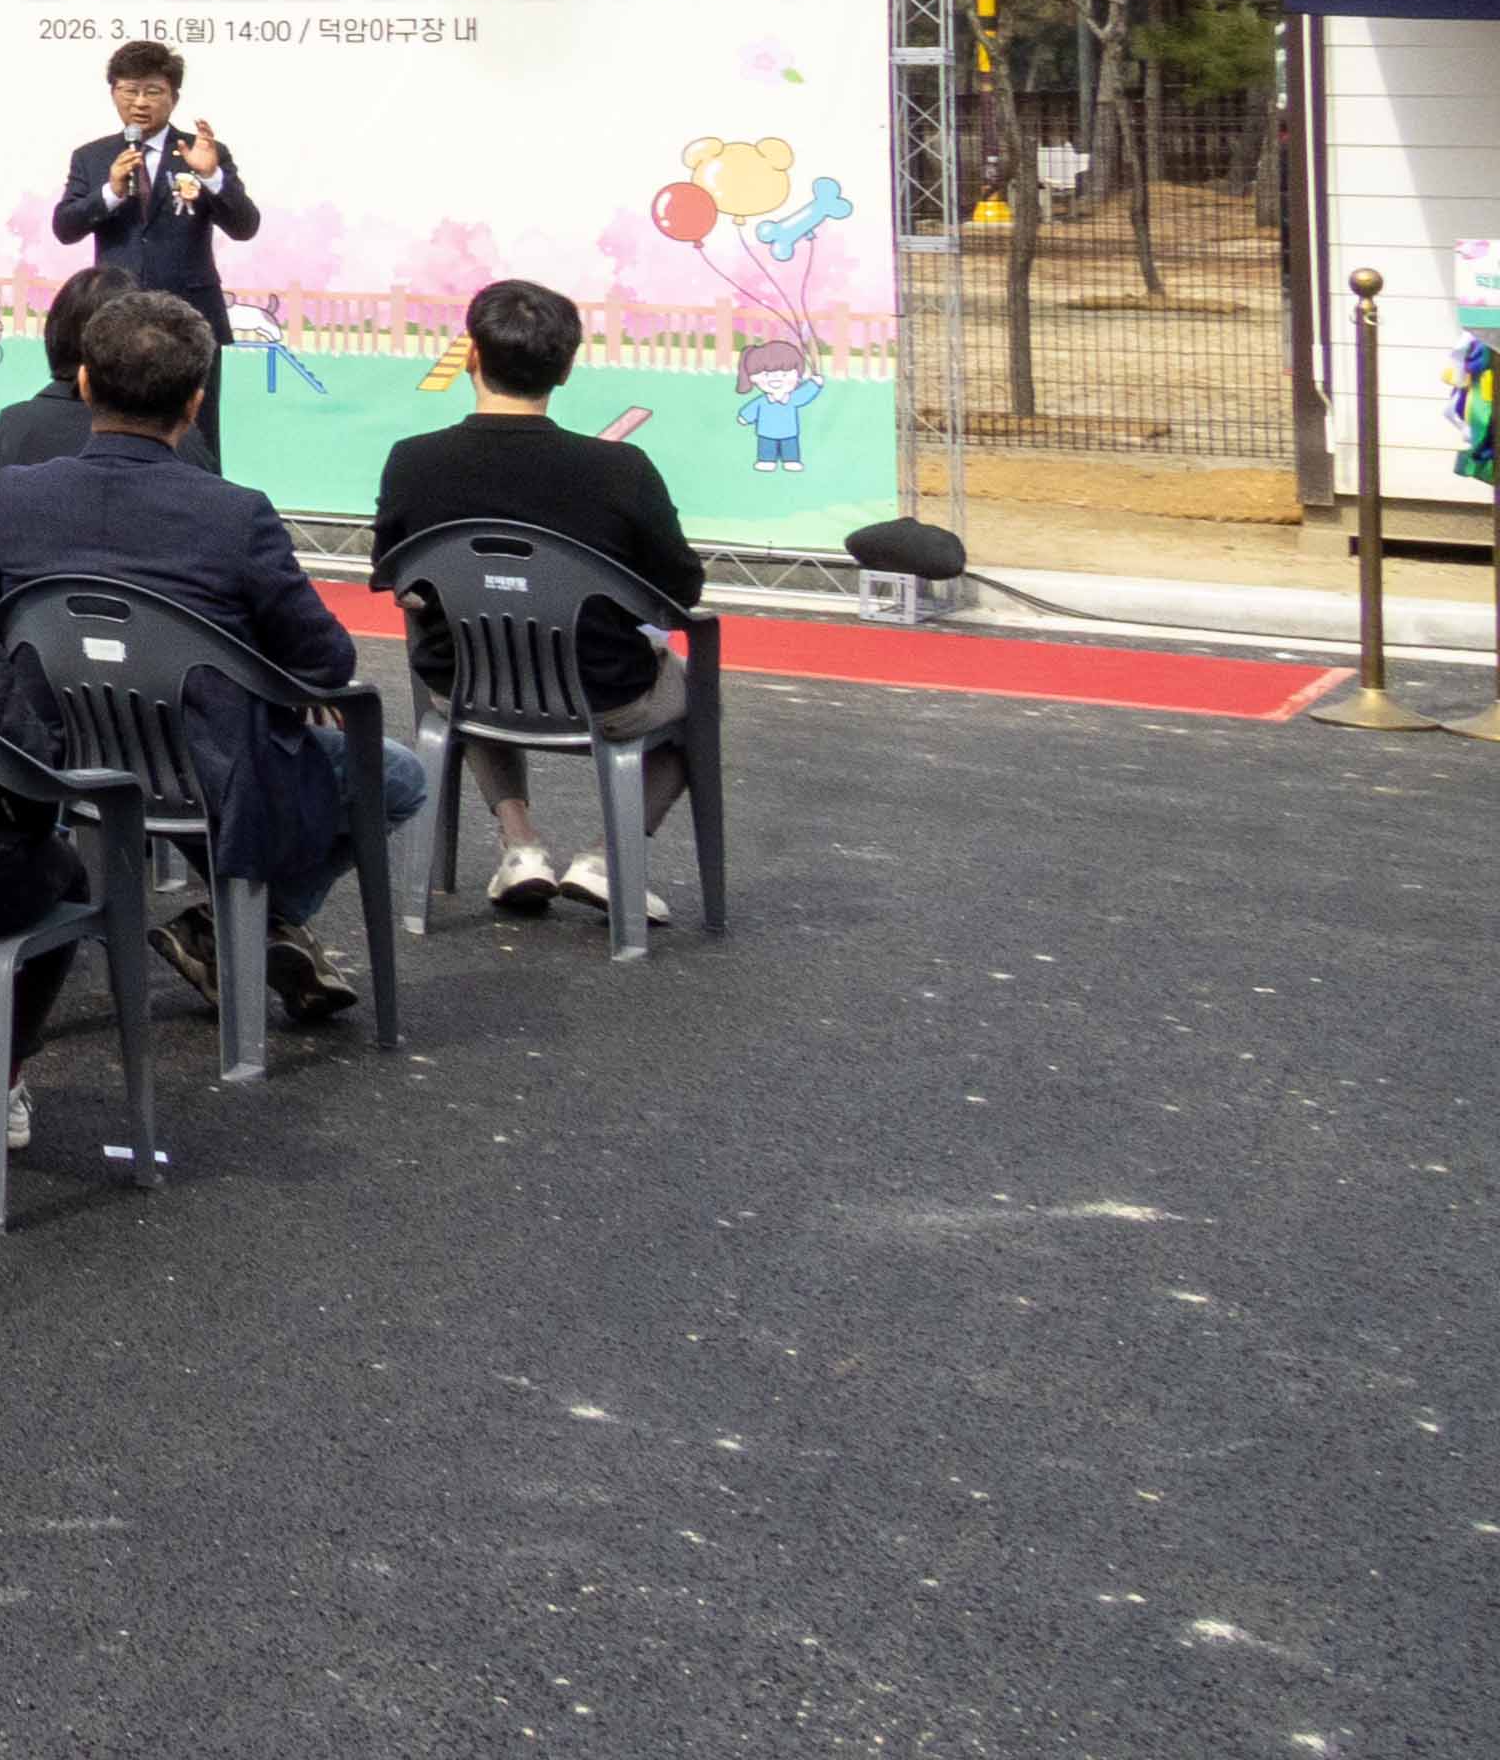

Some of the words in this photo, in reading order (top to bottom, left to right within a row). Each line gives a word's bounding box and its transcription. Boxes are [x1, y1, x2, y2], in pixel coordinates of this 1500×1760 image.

[40, 19, 102, 39] 2026.
[111, 19, 130, 39] 3.
[141, 18, 214, 41] 16.(월)
[226, 20, 291, 42] 14:00
[320, 18, 445, 43] 덕암야구장
[455, 18, 476, 41] 내
